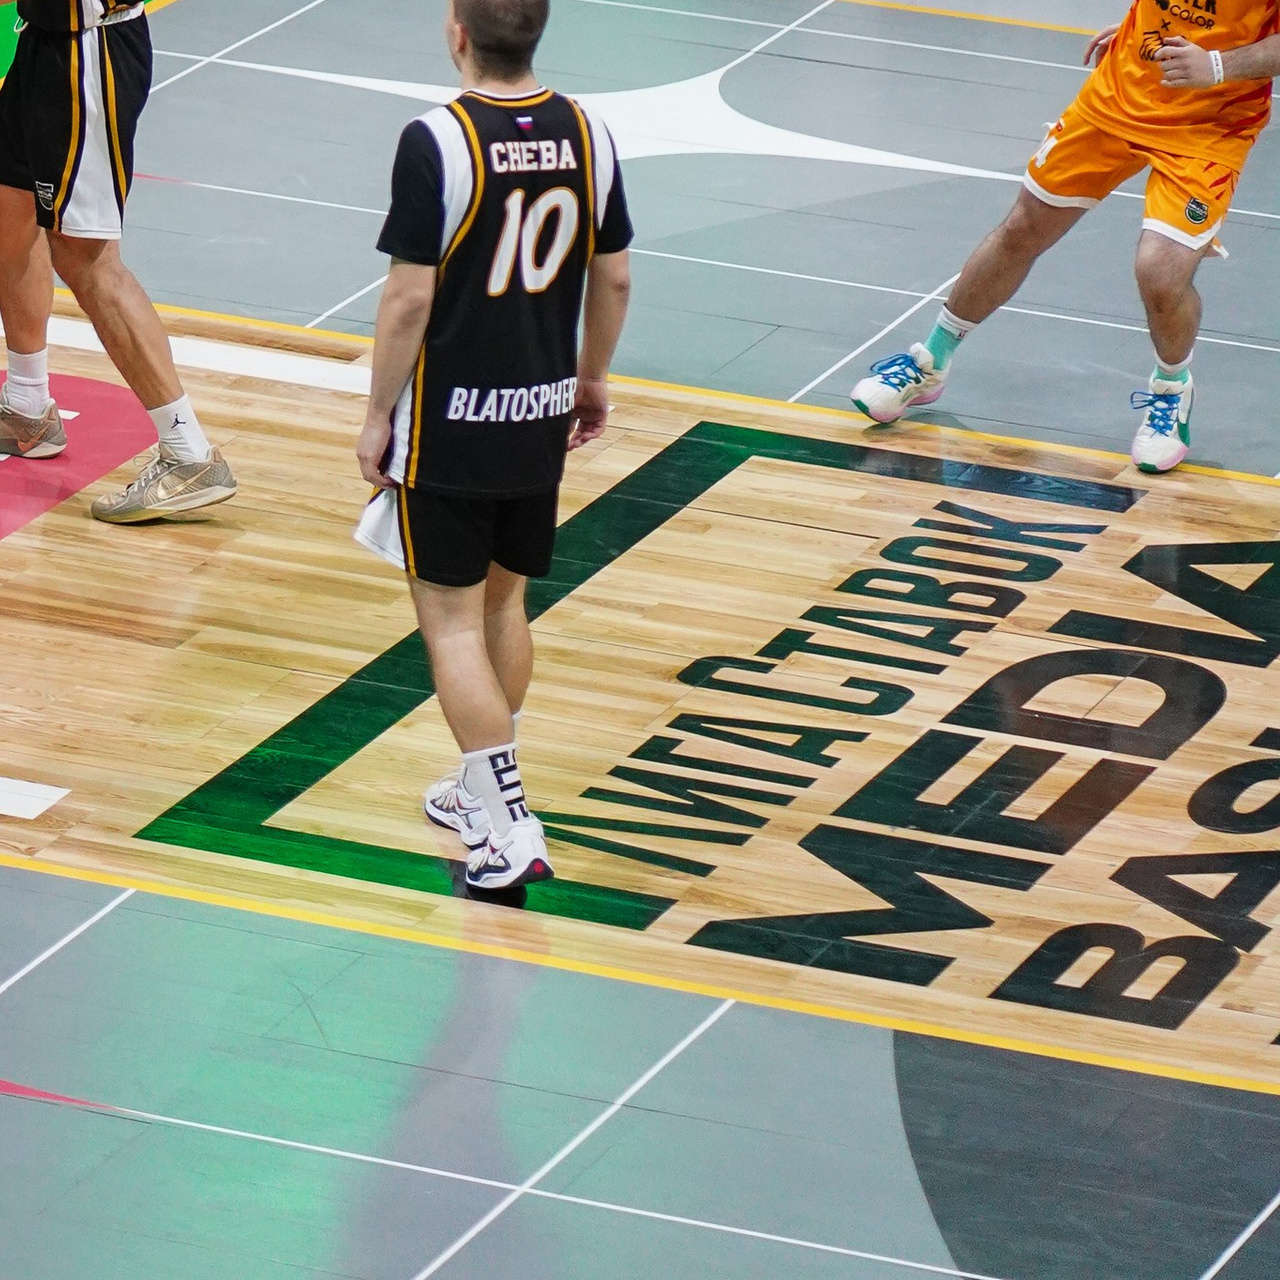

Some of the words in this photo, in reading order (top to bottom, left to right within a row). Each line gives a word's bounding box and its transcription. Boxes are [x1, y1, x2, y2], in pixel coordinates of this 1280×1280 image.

[1170, 4, 1215, 30] COLOR
[488, 139, 577, 174] CHEBA
[487, 187, 579, 297] 10
[677, 500, 1109, 717] СТАВОК
[488, 749, 530, 822] ELITE
[540, 713, 871, 877] ЛИГА
